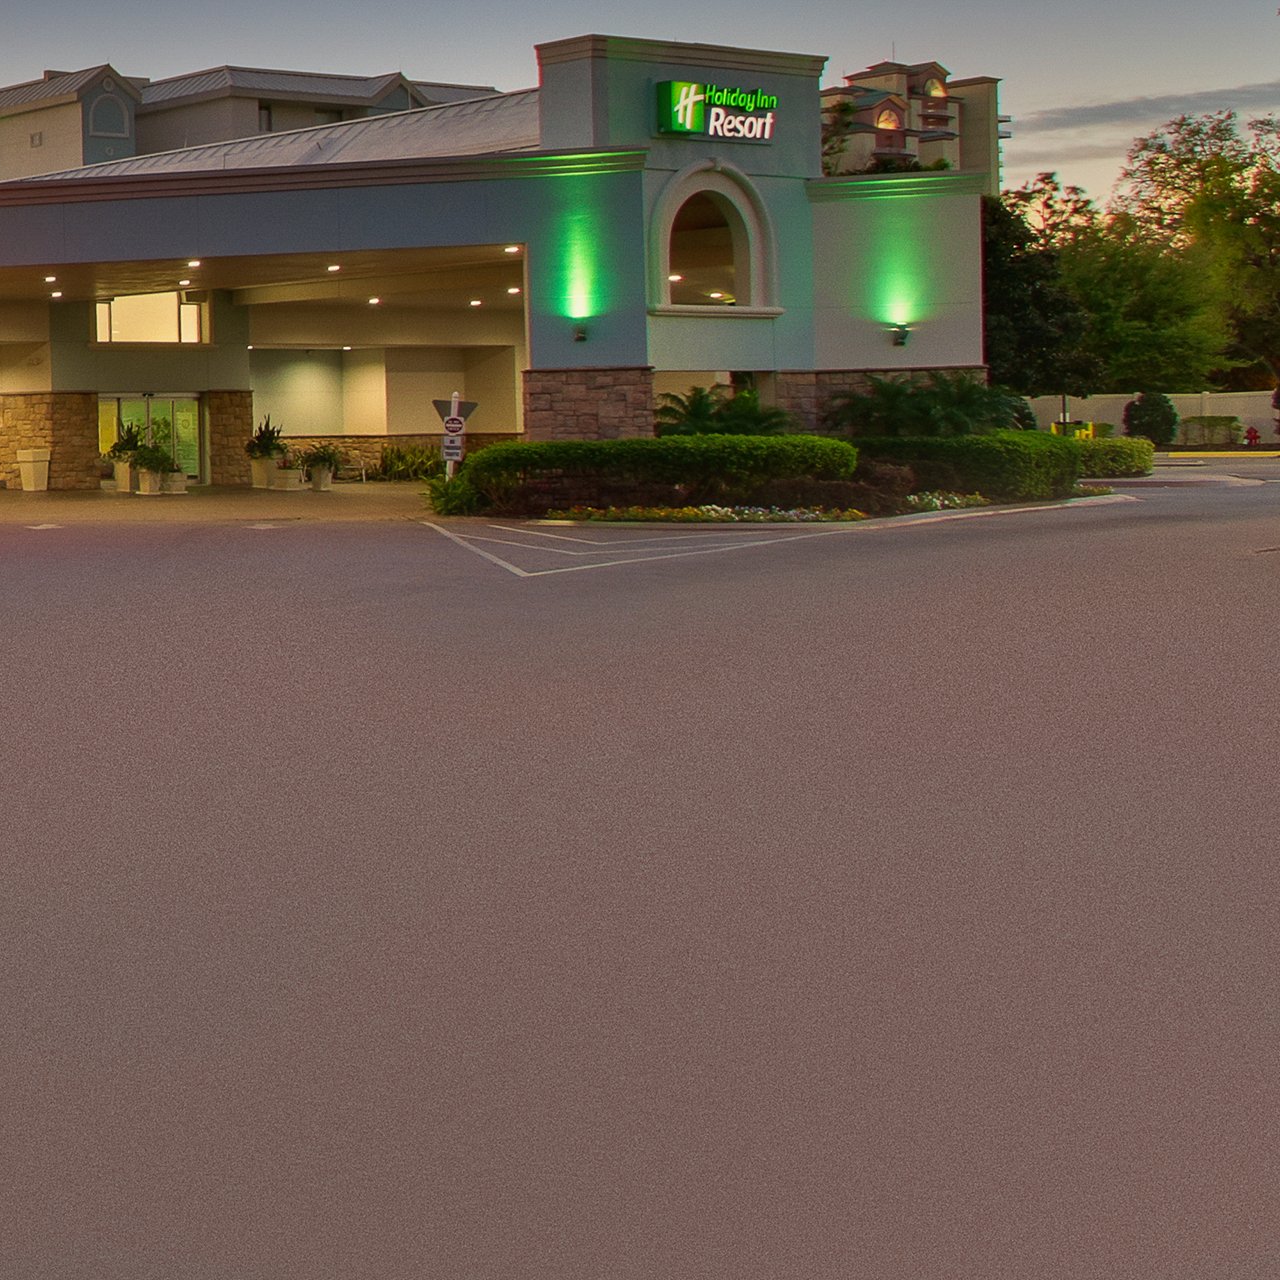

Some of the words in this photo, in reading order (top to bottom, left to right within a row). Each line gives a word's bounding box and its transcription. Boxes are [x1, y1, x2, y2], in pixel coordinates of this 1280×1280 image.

[705, 84, 756, 112] Holiday
[757, 89, 777, 108] Inn
[708, 107, 775, 140] Resort
